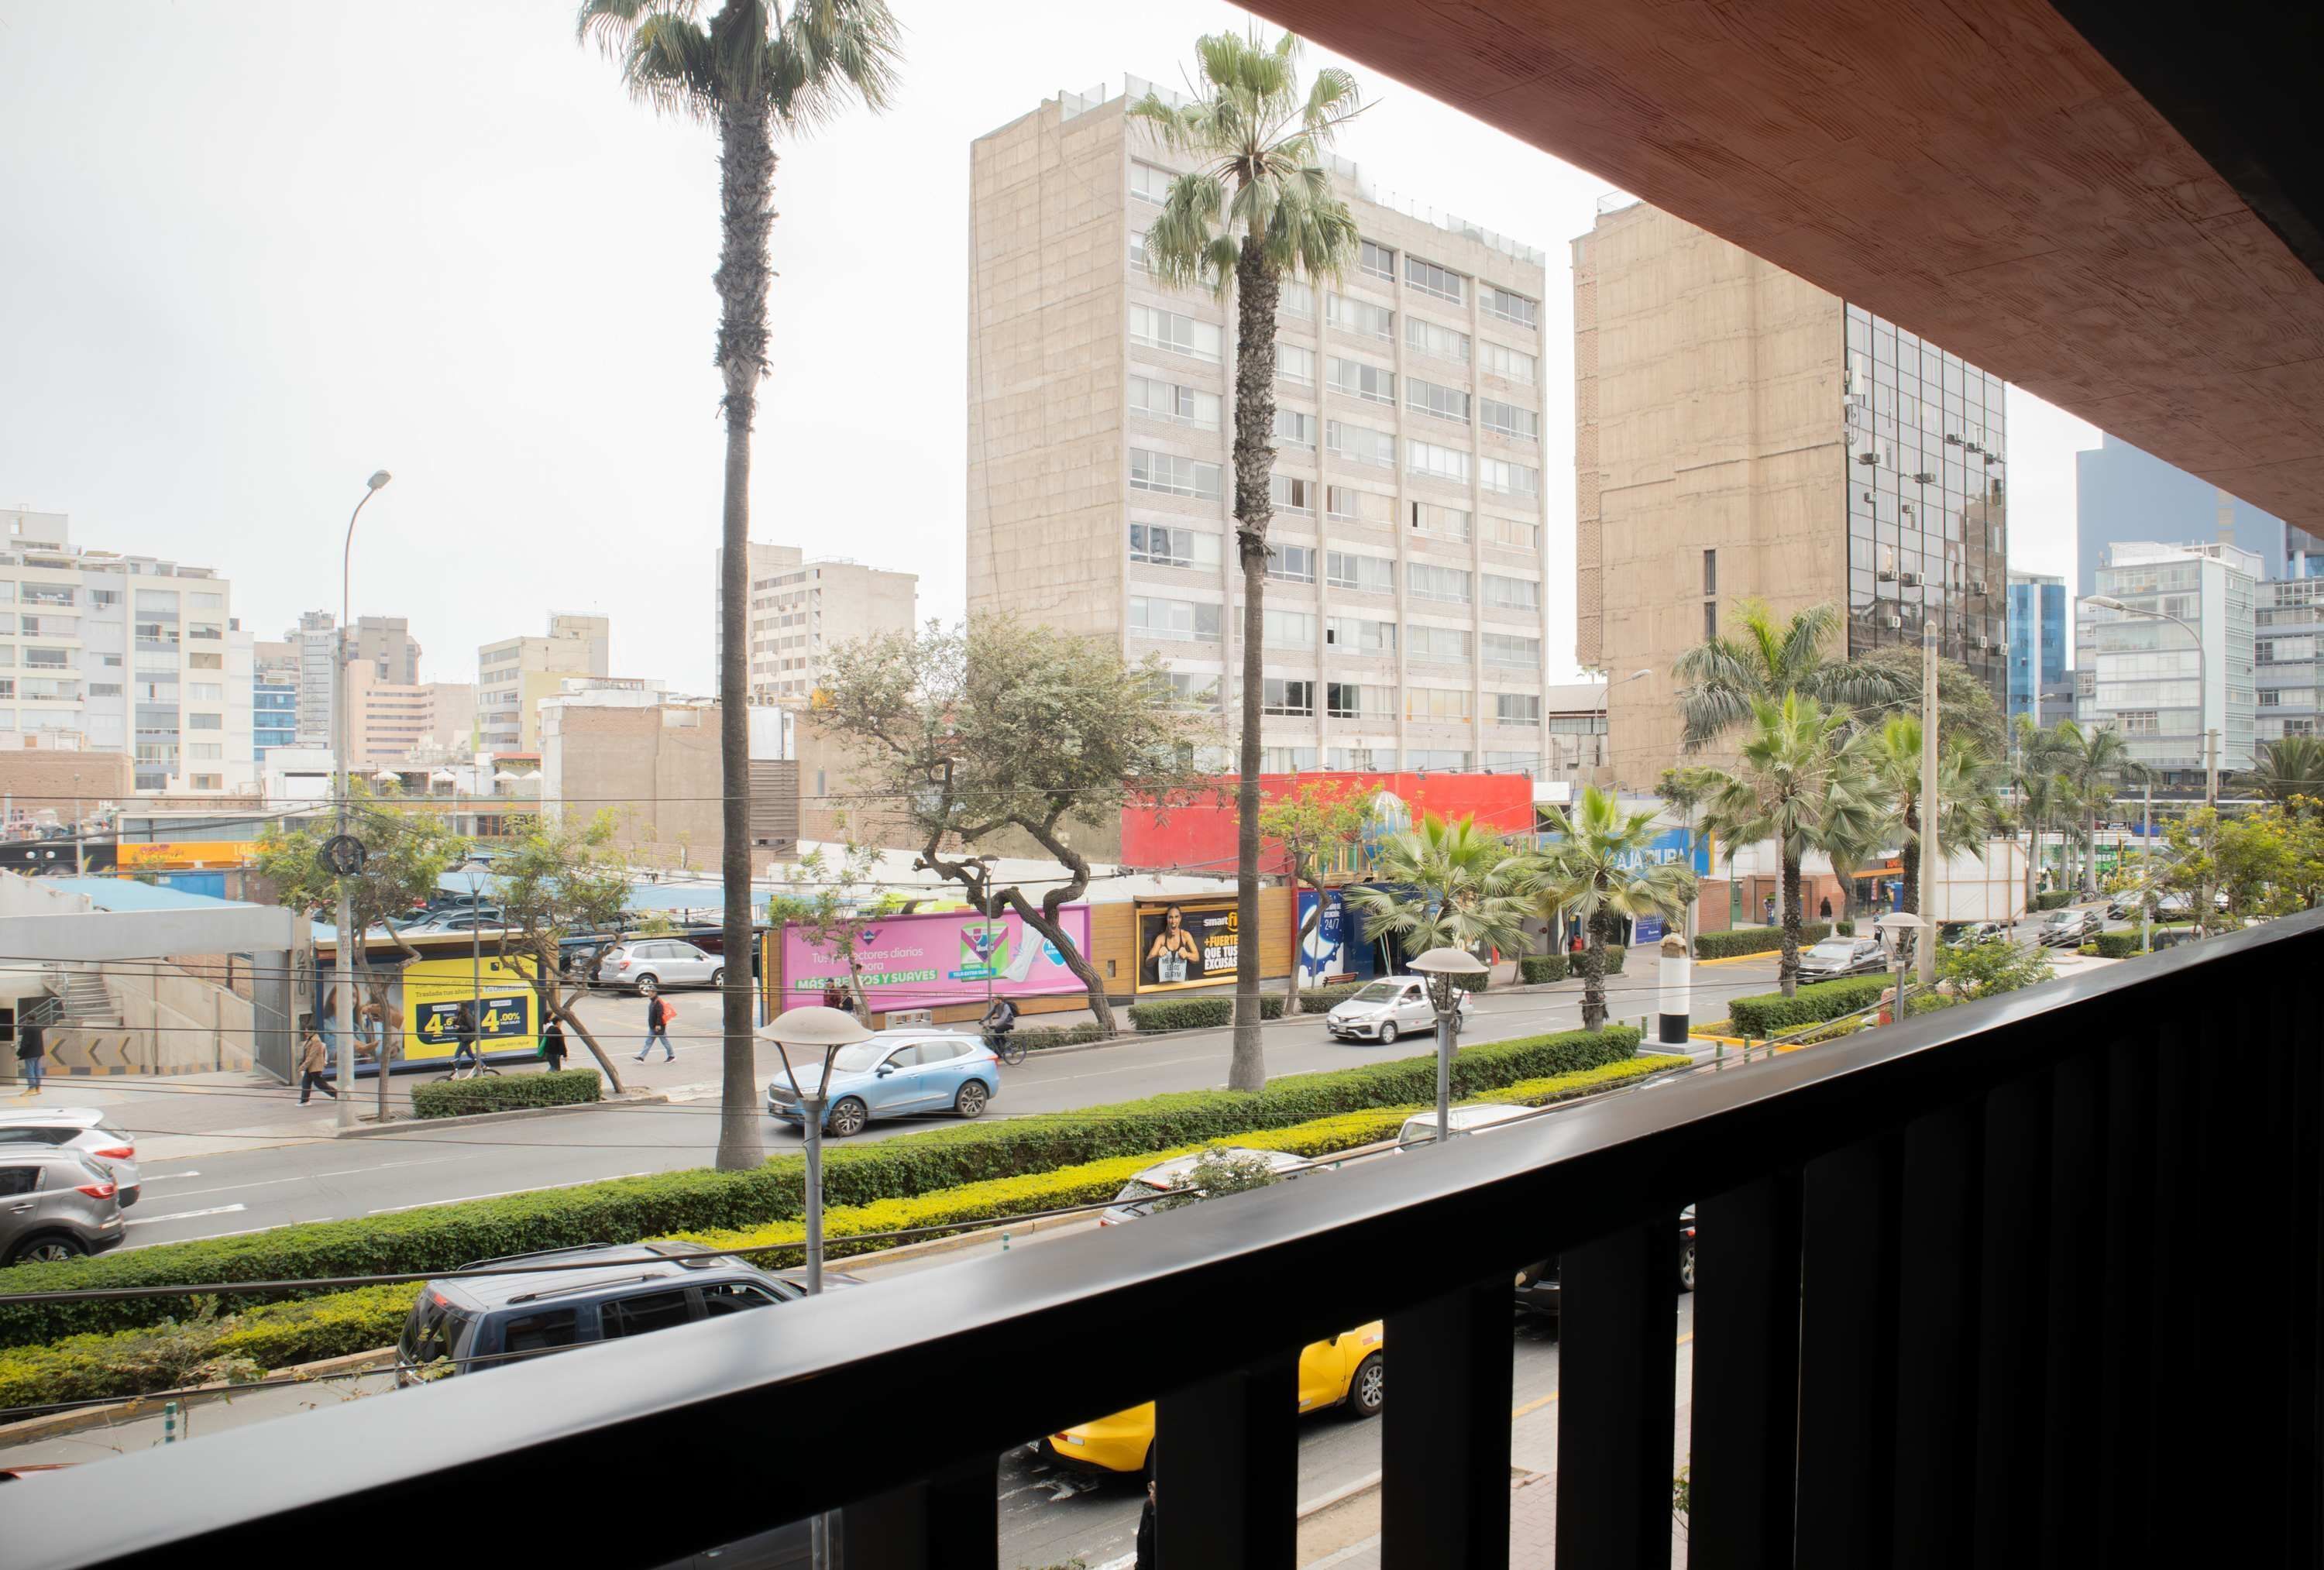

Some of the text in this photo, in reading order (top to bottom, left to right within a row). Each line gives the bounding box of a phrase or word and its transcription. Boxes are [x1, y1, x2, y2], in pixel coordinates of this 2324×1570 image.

[1325, 918, 1339, 930] 24/7
[890, 946, 924, 957] diarios
[1204, 945, 1239, 959] QUE TUS
[1205, 956, 1238, 971] EXCUSAS
[881, 974, 890, 984] Y
[892, 970, 937, 983] SUAVES
